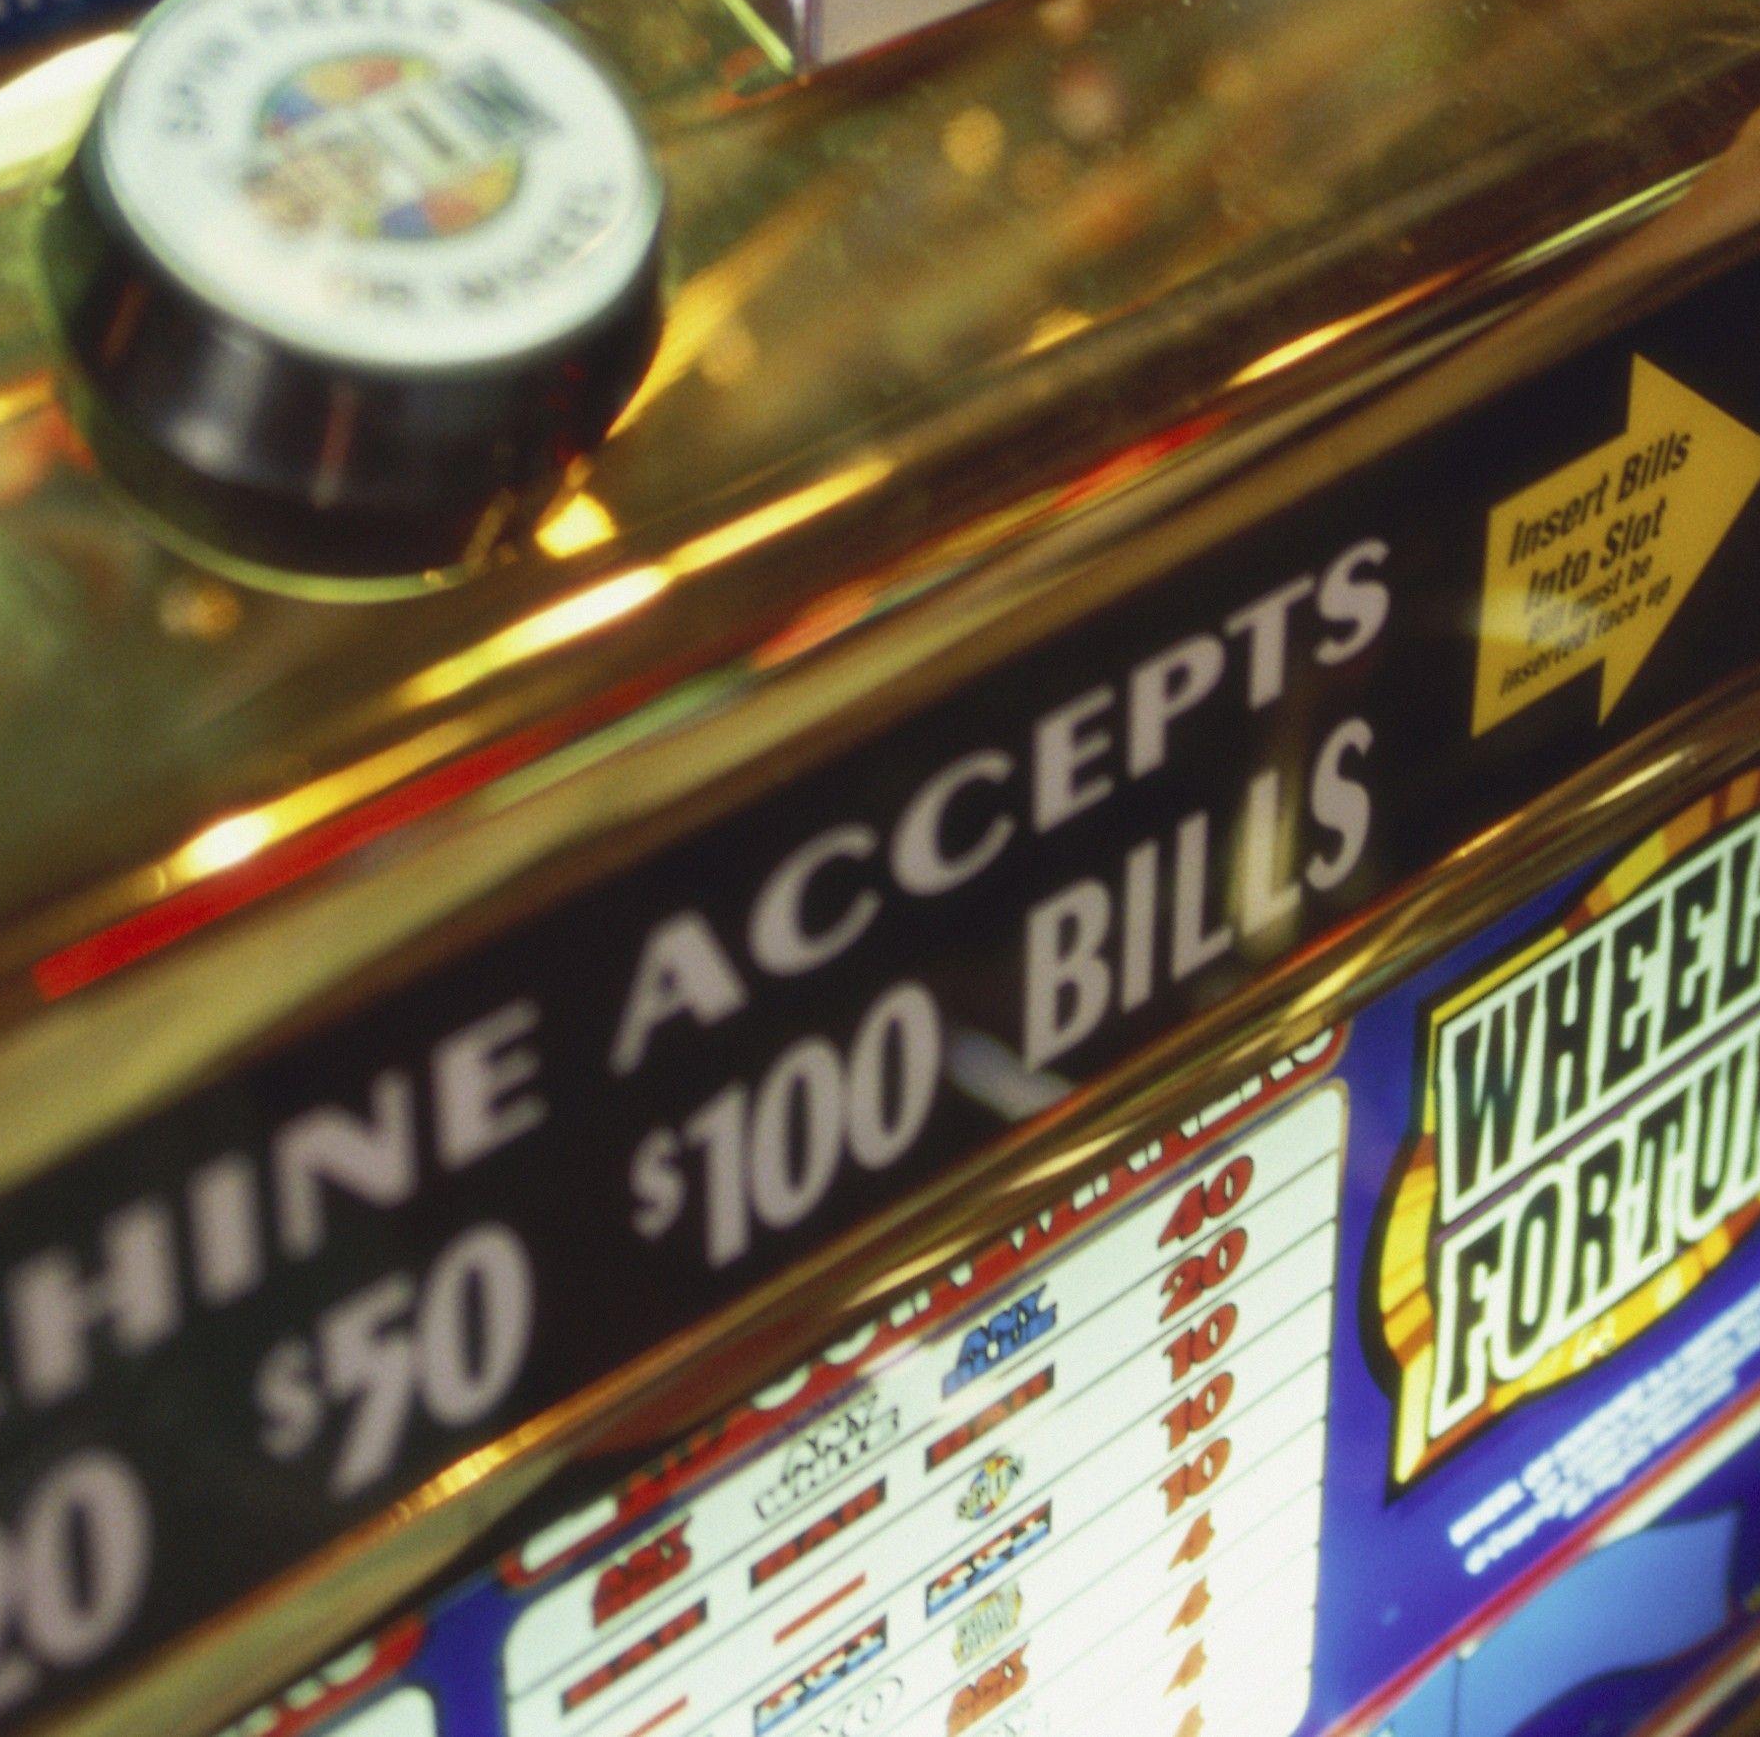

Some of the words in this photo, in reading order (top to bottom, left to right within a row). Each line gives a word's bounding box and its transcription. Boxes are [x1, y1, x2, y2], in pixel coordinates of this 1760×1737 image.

[1508, 471, 1610, 568] Insert
[1616, 430, 1692, 504] Bills
[1525, 548, 1592, 614] Into
[1598, 495, 1667, 571] Slot
[1626, 554, 1653, 586] be
[1499, 618, 1593, 696] inserted
[1595, 594, 1642, 637] face
[1645, 574, 1672, 607] up
[610, 536, 1392, 1073] ACCEPTS
[254, 1221, 536, 1500] $50
[628, 979, 945, 1266] $100
[1023, 717, 1375, 1072] BILLS
[1158, 1154, 1254, 1250] 40
[1159, 1226, 1249, 1324] 20
[1161, 1301, 1238, 1383] 10
[1159, 1371, 1235, 1451] 10
[1157, 1436, 1232, 1517] 10
